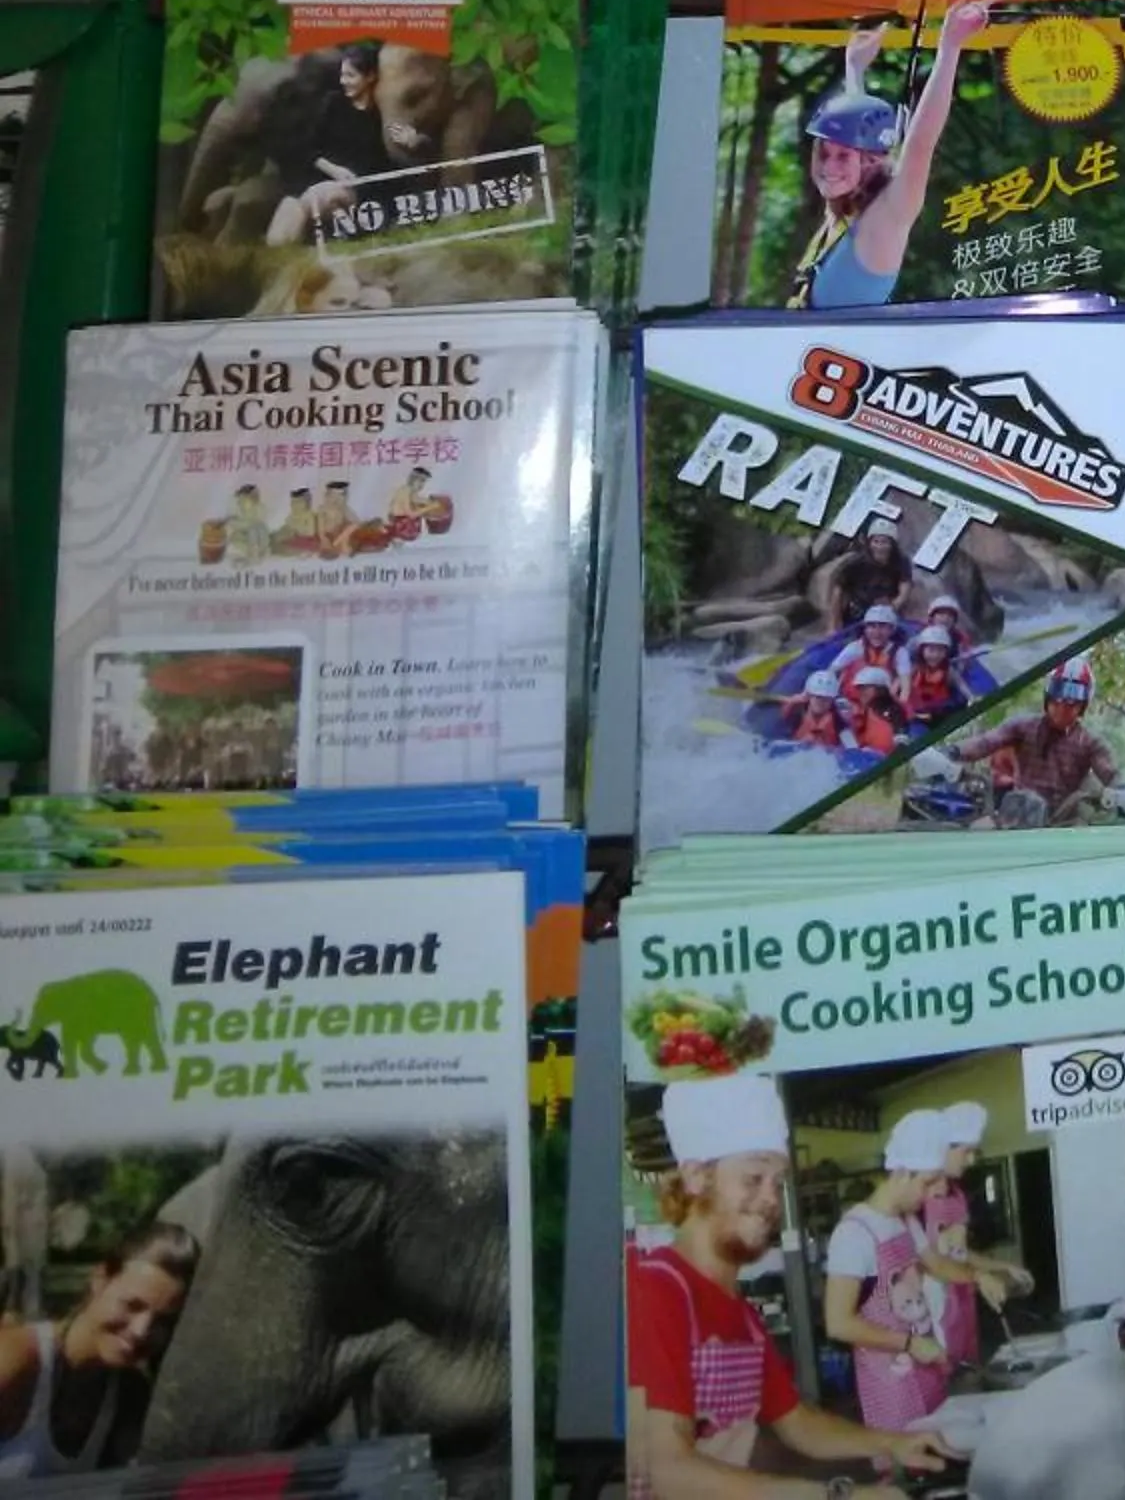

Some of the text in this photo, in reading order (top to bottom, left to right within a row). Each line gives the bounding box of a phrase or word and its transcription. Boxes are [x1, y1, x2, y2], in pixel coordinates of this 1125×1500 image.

[332, 173, 534, 238] NO RIDING
[941, 140, 1121, 234] 享受人生
[952, 216, 1078, 270] 极致乐趣
[178, 341, 481, 398] Asia Scenic
[789, 344, 871, 423] 8
[145, 388, 516, 435] Thai Cooking School
[182, 436, 462, 473] 亚洲风情泰国烹饪学校
[677, 413, 999, 572] RAFT
[171, 932, 442, 990] Elephant
[640, 926, 783, 982] Smile
[796, 900, 998, 972] Organic
[171, 990, 505, 1046] Retirement
[779, 980, 975, 1034] Cooking
[171, 1050, 310, 1102] Park
